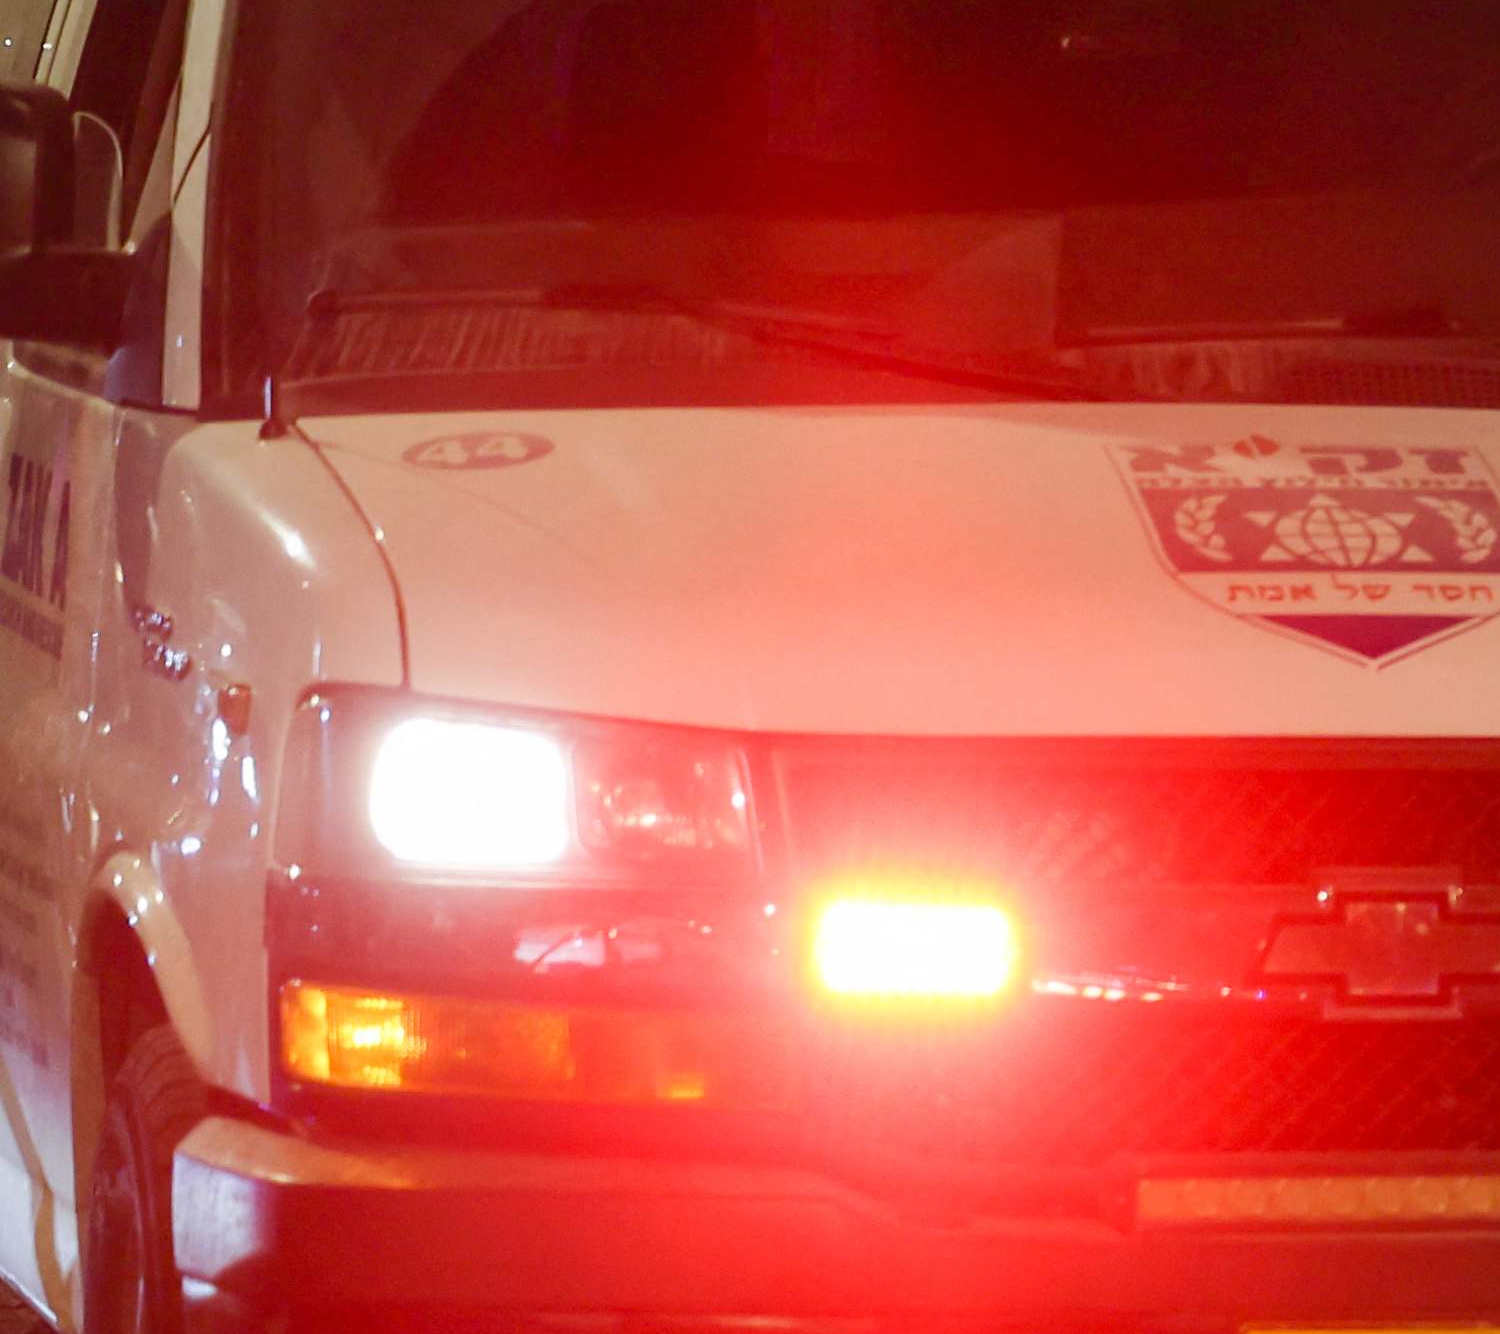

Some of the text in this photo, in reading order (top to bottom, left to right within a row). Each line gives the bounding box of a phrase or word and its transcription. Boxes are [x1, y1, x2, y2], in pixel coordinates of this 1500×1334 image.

[415, 434, 529, 465] 44
[1227, 583, 1318, 604] אמת
[1331, 572, 1392, 602] של
